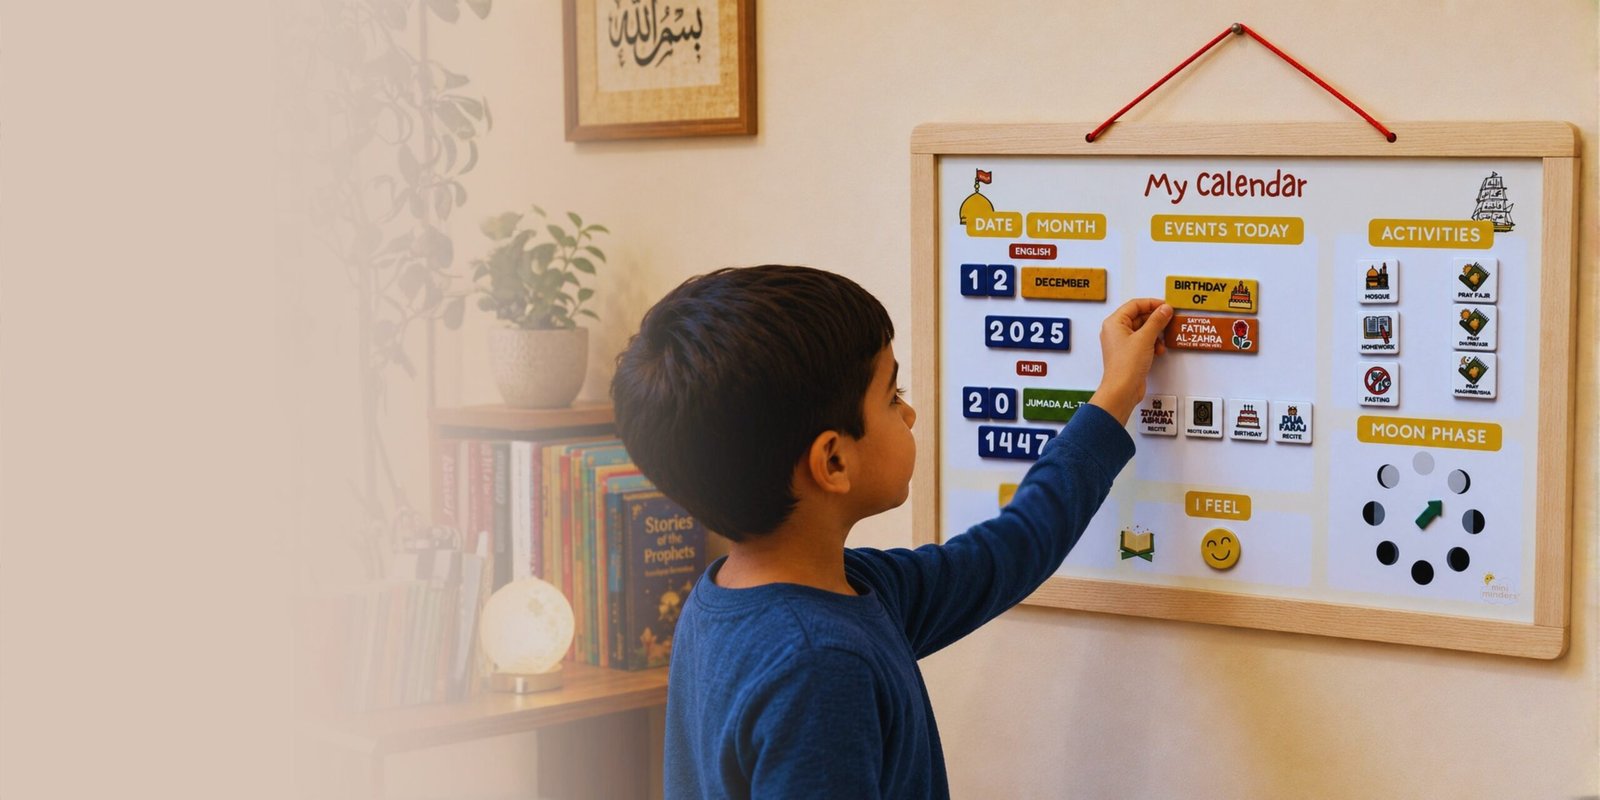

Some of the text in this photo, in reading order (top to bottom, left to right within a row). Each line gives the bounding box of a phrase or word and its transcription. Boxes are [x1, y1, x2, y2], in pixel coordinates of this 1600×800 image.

[1144, 169, 1307, 204] My Calendar
[975, 217, 1013, 231] DATE
[1037, 219, 1096, 233] MONTH
[1164, 221, 1290, 238] EVENTS TODAY
[1381, 226, 1481, 242] ACTIVITIES
[1015, 247, 1051, 256] ENGLISH
[1035, 277, 1090, 288] DECEMBER
[1174, 280, 1227, 292] BIRTHDAY
[1192, 294, 1208, 304] OF
[989, 320, 1064, 344] 2025
[1181, 324, 1217, 334] FATIMA
[1176, 333, 1223, 344] AL-ZAHRA
[1021, 364, 1042, 373] HIJRI
[1025, 399, 1061, 408] JUMADA
[1140, 409, 1174, 418] ZIYARAT
[1281, 415, 1304, 425] DUA
[1279, 423, 1307, 432] FARAJ
[1371, 423, 1487, 443] MOON PHASE
[985, 430, 1049, 455] 1447
[1195, 498, 1240, 514] I FEEL
[645, 514, 694, 534] Stories
[657, 532, 683, 546] of the
[644, 546, 695, 564] Prophets
